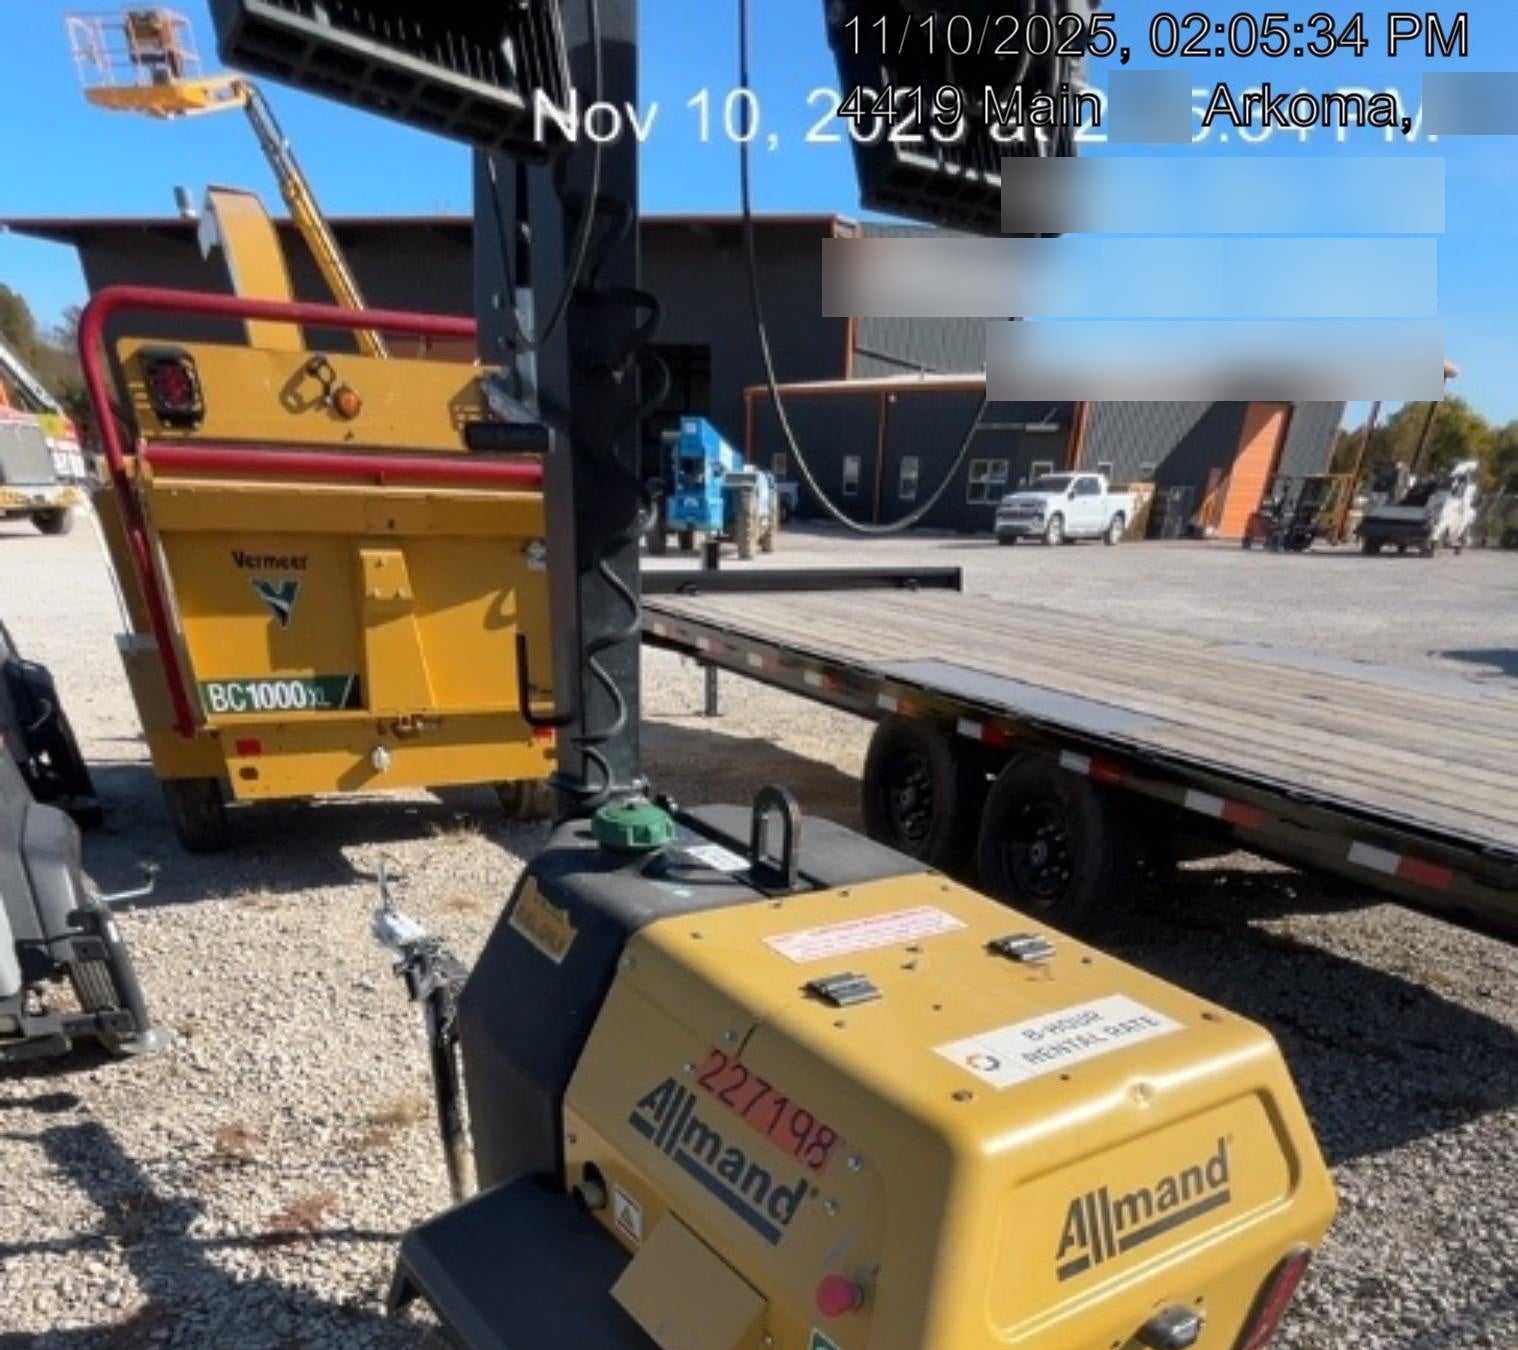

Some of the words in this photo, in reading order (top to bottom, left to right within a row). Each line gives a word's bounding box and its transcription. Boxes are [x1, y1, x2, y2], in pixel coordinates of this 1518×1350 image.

[231, 551, 308, 571] Vermeer
[1021, 1032, 1109, 1064] RENTAL
[1103, 1016, 1161, 1037] RATE
[636, 1076, 809, 1226] Allmand
[699, 1048, 838, 1171] 227198
[1056, 1136, 1230, 1265] Allmand
